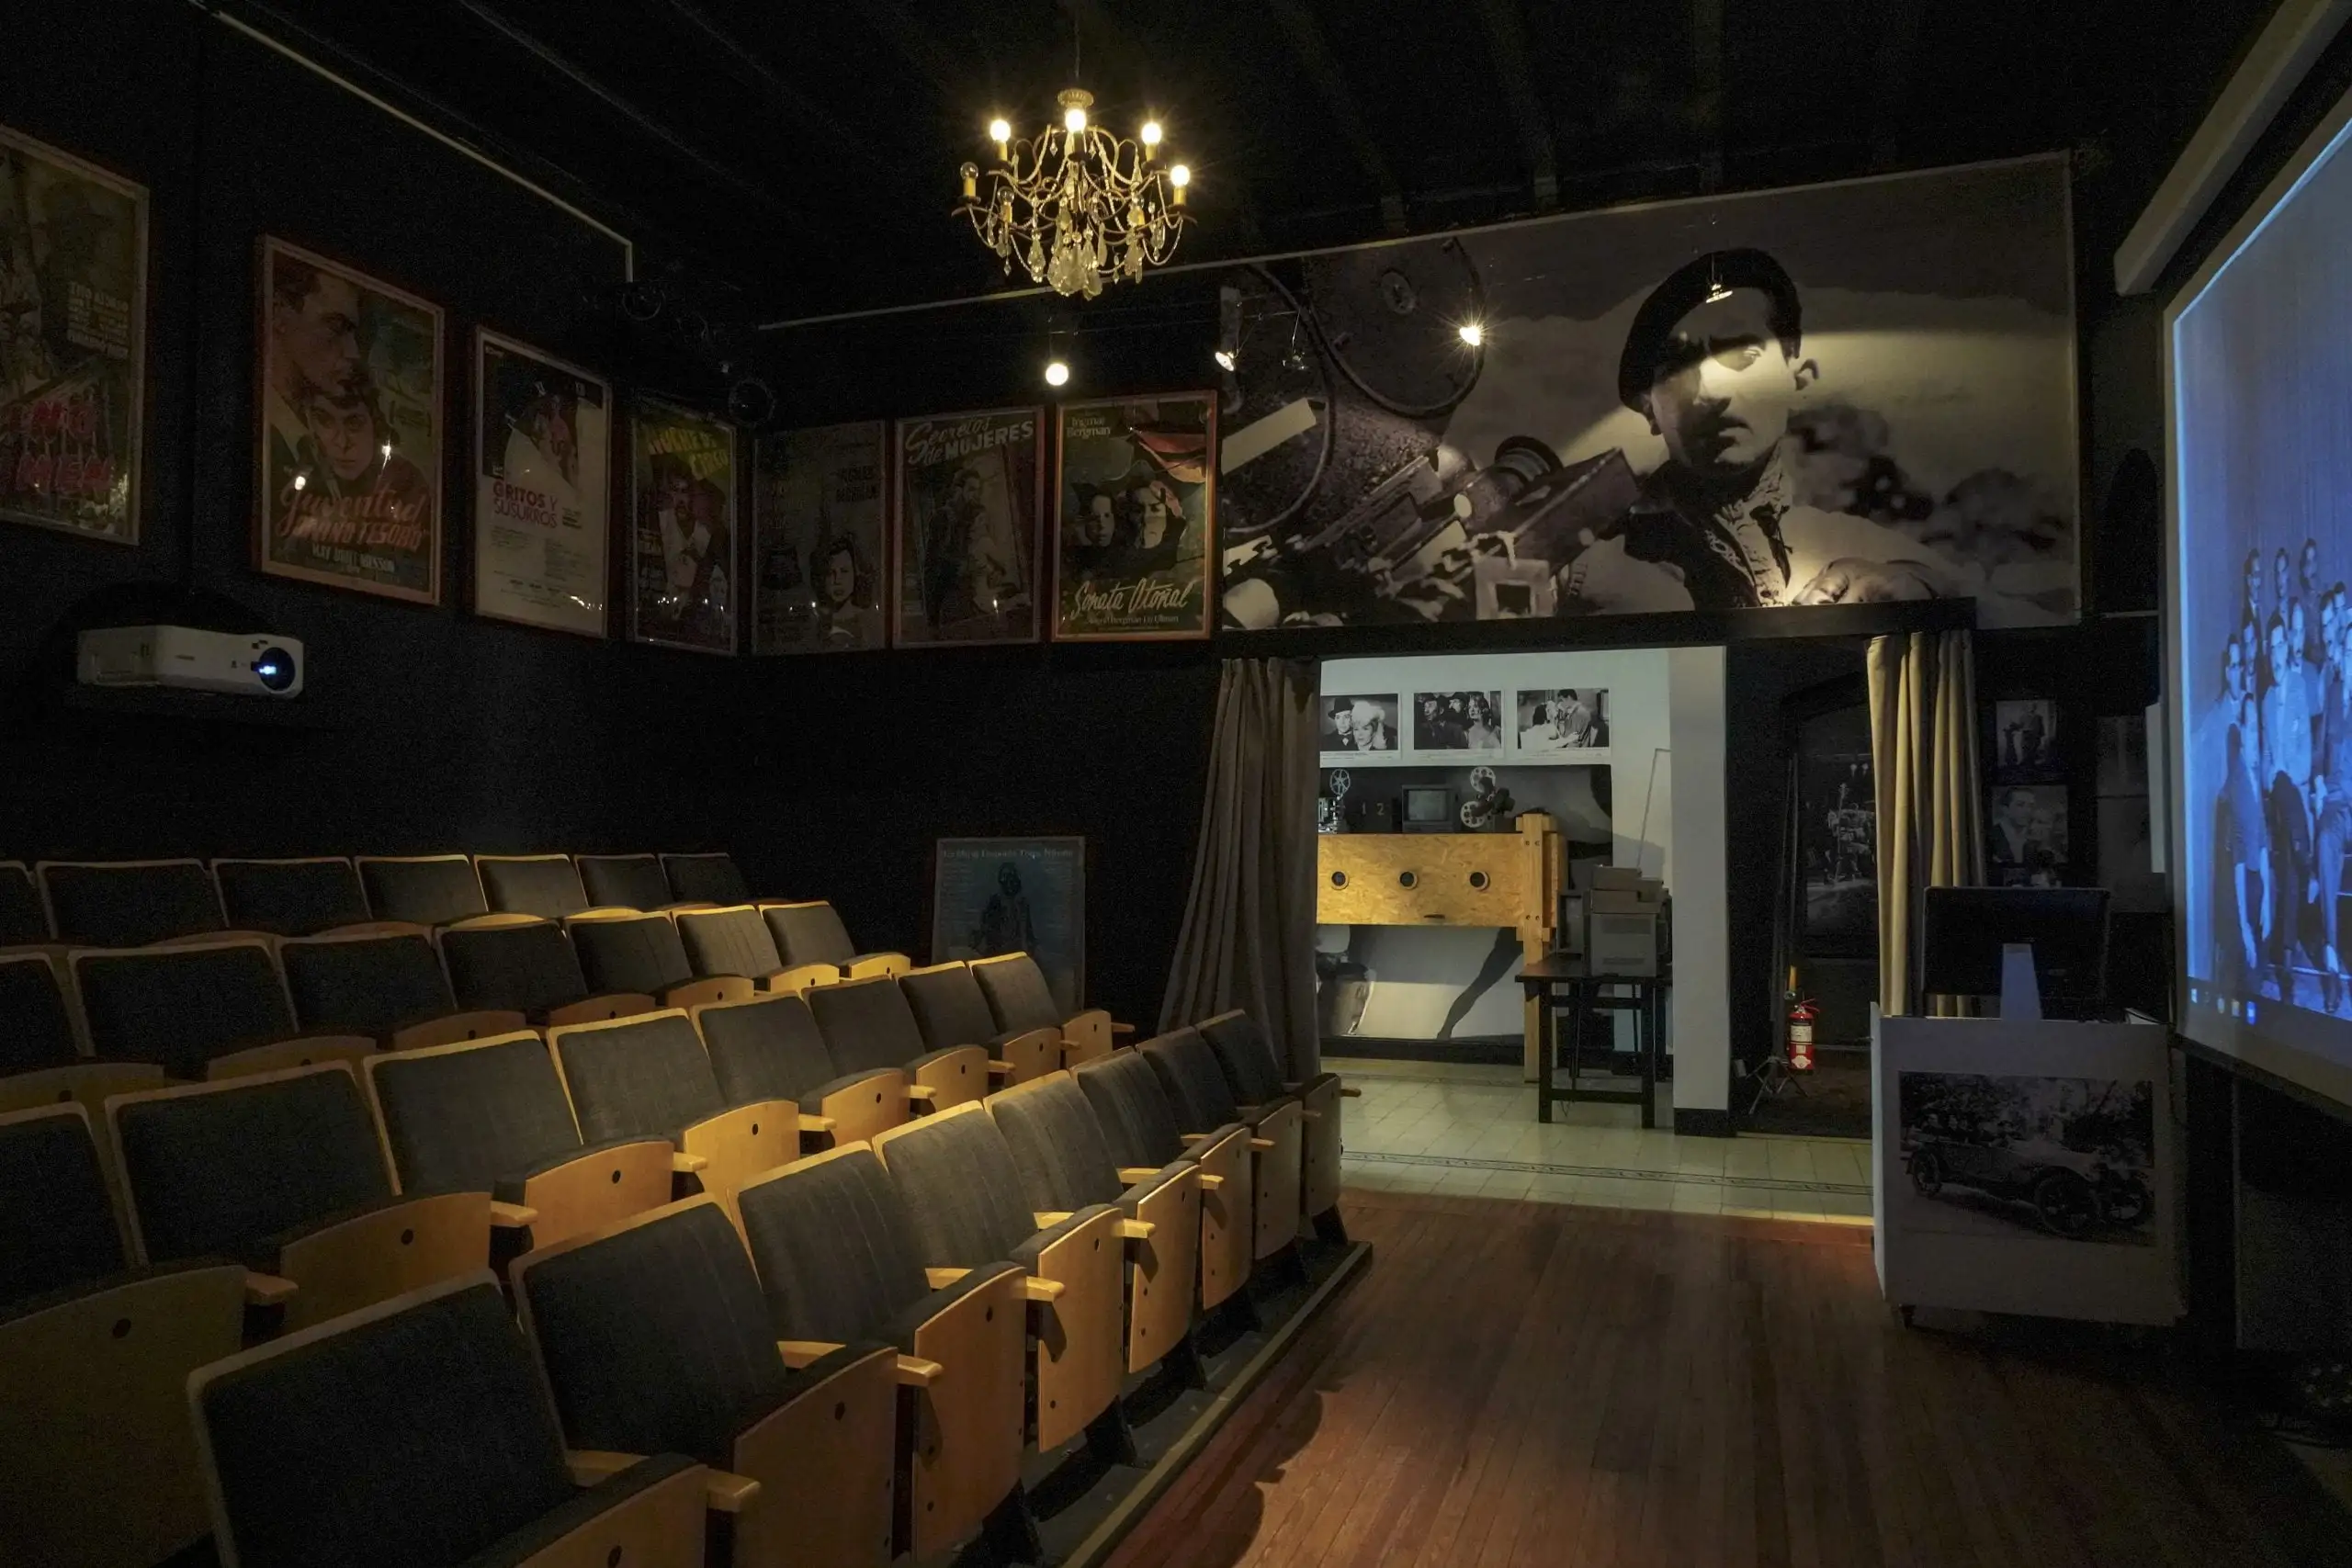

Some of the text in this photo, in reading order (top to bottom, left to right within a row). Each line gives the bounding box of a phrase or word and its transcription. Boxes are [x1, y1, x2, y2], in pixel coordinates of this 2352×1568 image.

[905, 415, 992, 466] Secretos
[944, 420, 1035, 461] MUJERES
[1066, 426, 1111, 440] Bergman
[492, 479, 560, 512] GRITOS Y
[492, 498, 559, 530] SUSURROS
[1070, 579, 1136, 621] Sonata
[1361, 801, 1386, 816] 1 2
